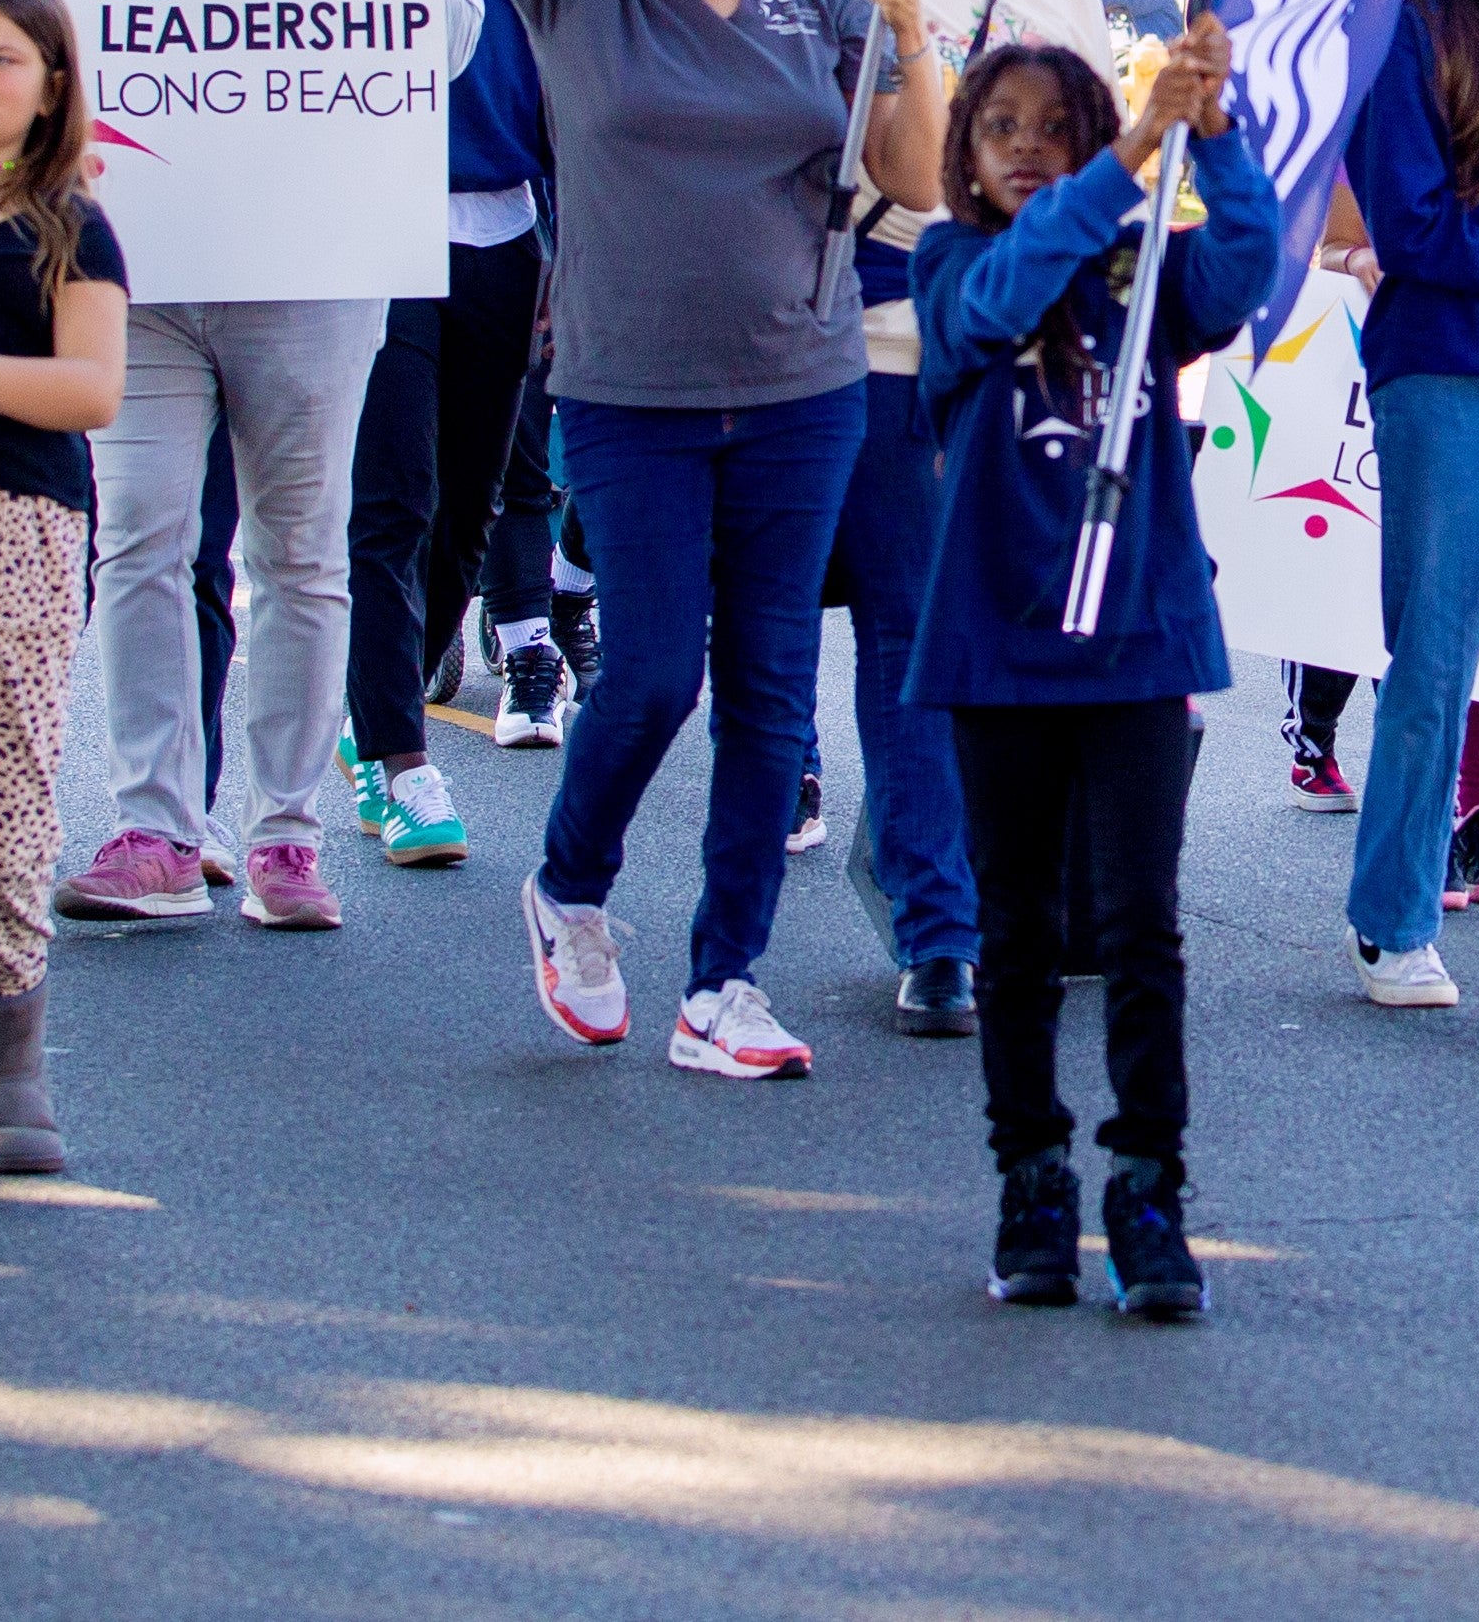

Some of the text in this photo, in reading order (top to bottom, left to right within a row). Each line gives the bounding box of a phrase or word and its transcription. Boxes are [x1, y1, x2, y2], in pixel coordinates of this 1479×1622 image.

[101, 1, 430, 54] LEADERSHIP
[97, 69, 436, 117] LONG BEACH
